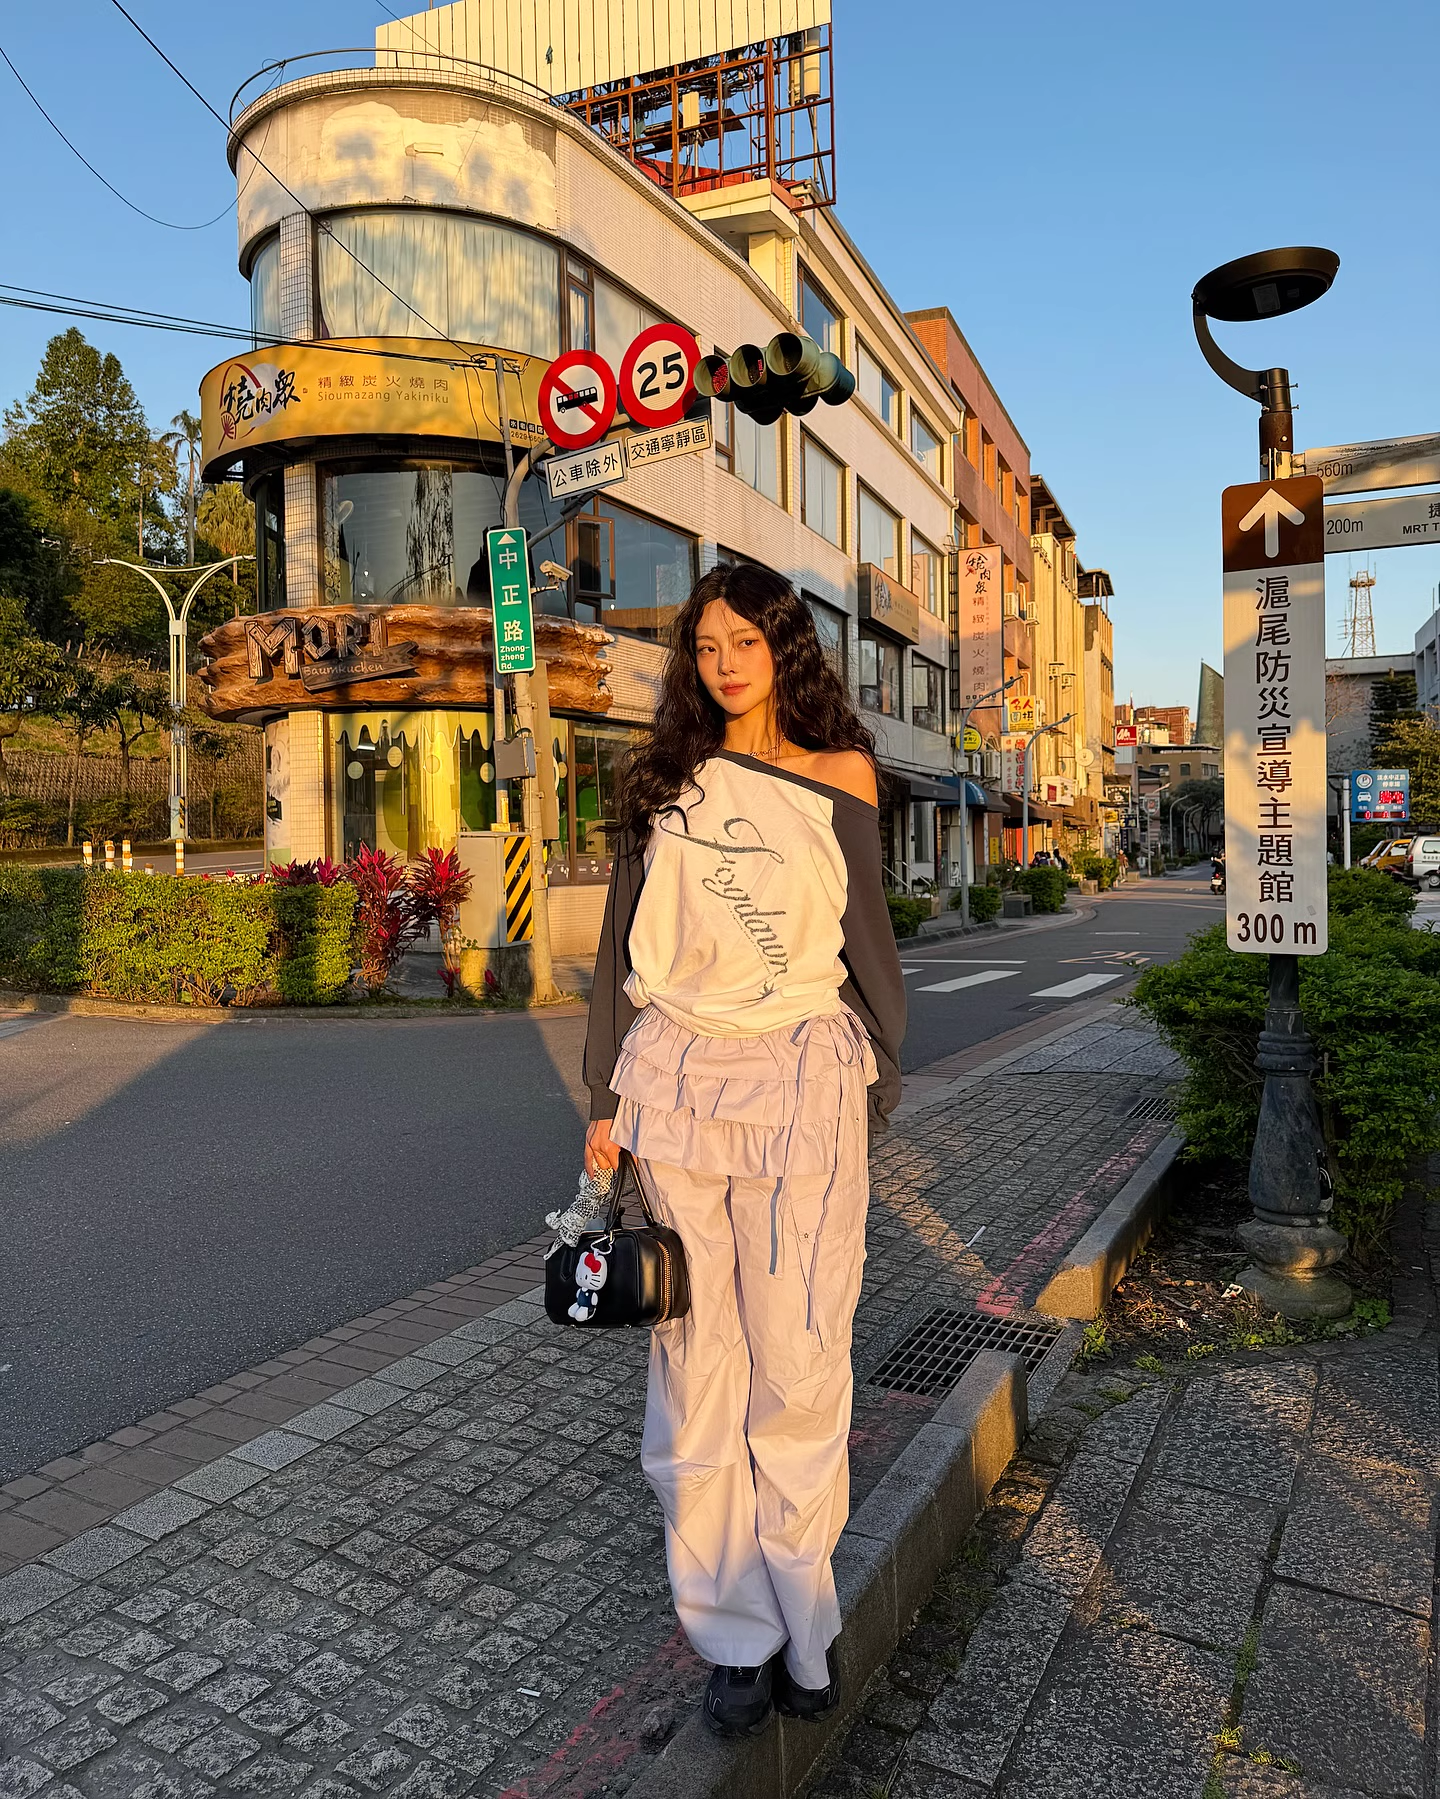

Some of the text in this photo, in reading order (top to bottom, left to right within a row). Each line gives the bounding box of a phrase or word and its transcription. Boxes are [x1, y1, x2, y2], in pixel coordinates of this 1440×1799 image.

[318, 375, 449, 391] 精緻炭火燒肉
[637, 351, 685, 399] 25
[318, 390, 449, 404] Sioumazang Yakiniku
[631, 426, 706, 461] 交通寧靜區
[553, 453, 618, 488] 公車除外
[1317, 462, 1353, 478] 560m
[1326, 518, 1364, 535] 200m
[1402, 523, 1429, 535] MRT
[499, 548, 523, 642] 中正路
[244, 613, 386, 680] MORI
[500, 645, 530, 653] Zhong-
[304, 662, 383, 676] Baumkuchen
[501, 662, 515, 670] Rd.
[1255, 575, 1294, 904] 滬尾防災宣導主題館
[1237, 912, 1317, 945] 300 m
